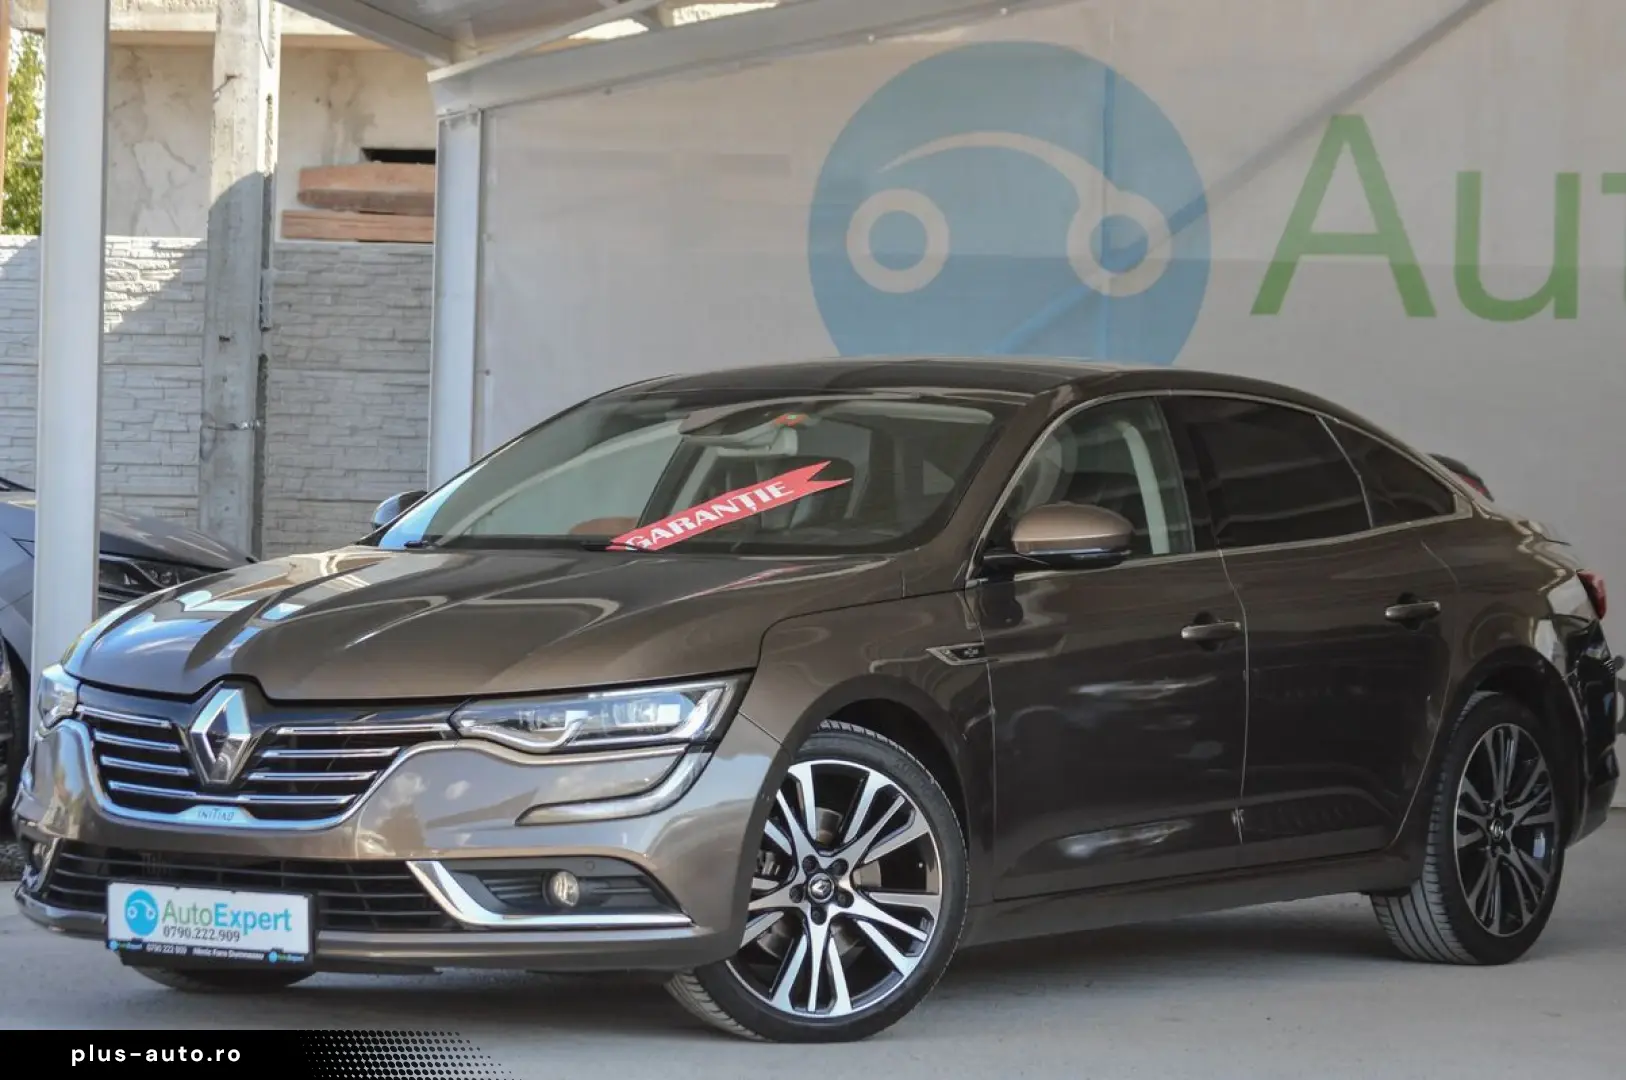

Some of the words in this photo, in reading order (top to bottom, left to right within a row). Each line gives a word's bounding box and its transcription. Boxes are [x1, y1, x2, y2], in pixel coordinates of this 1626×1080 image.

[625, 481, 795, 551] GARANȚIE
[162, 900, 292, 936] AutoExpert
[163, 926, 240, 942] 0790.222.909
